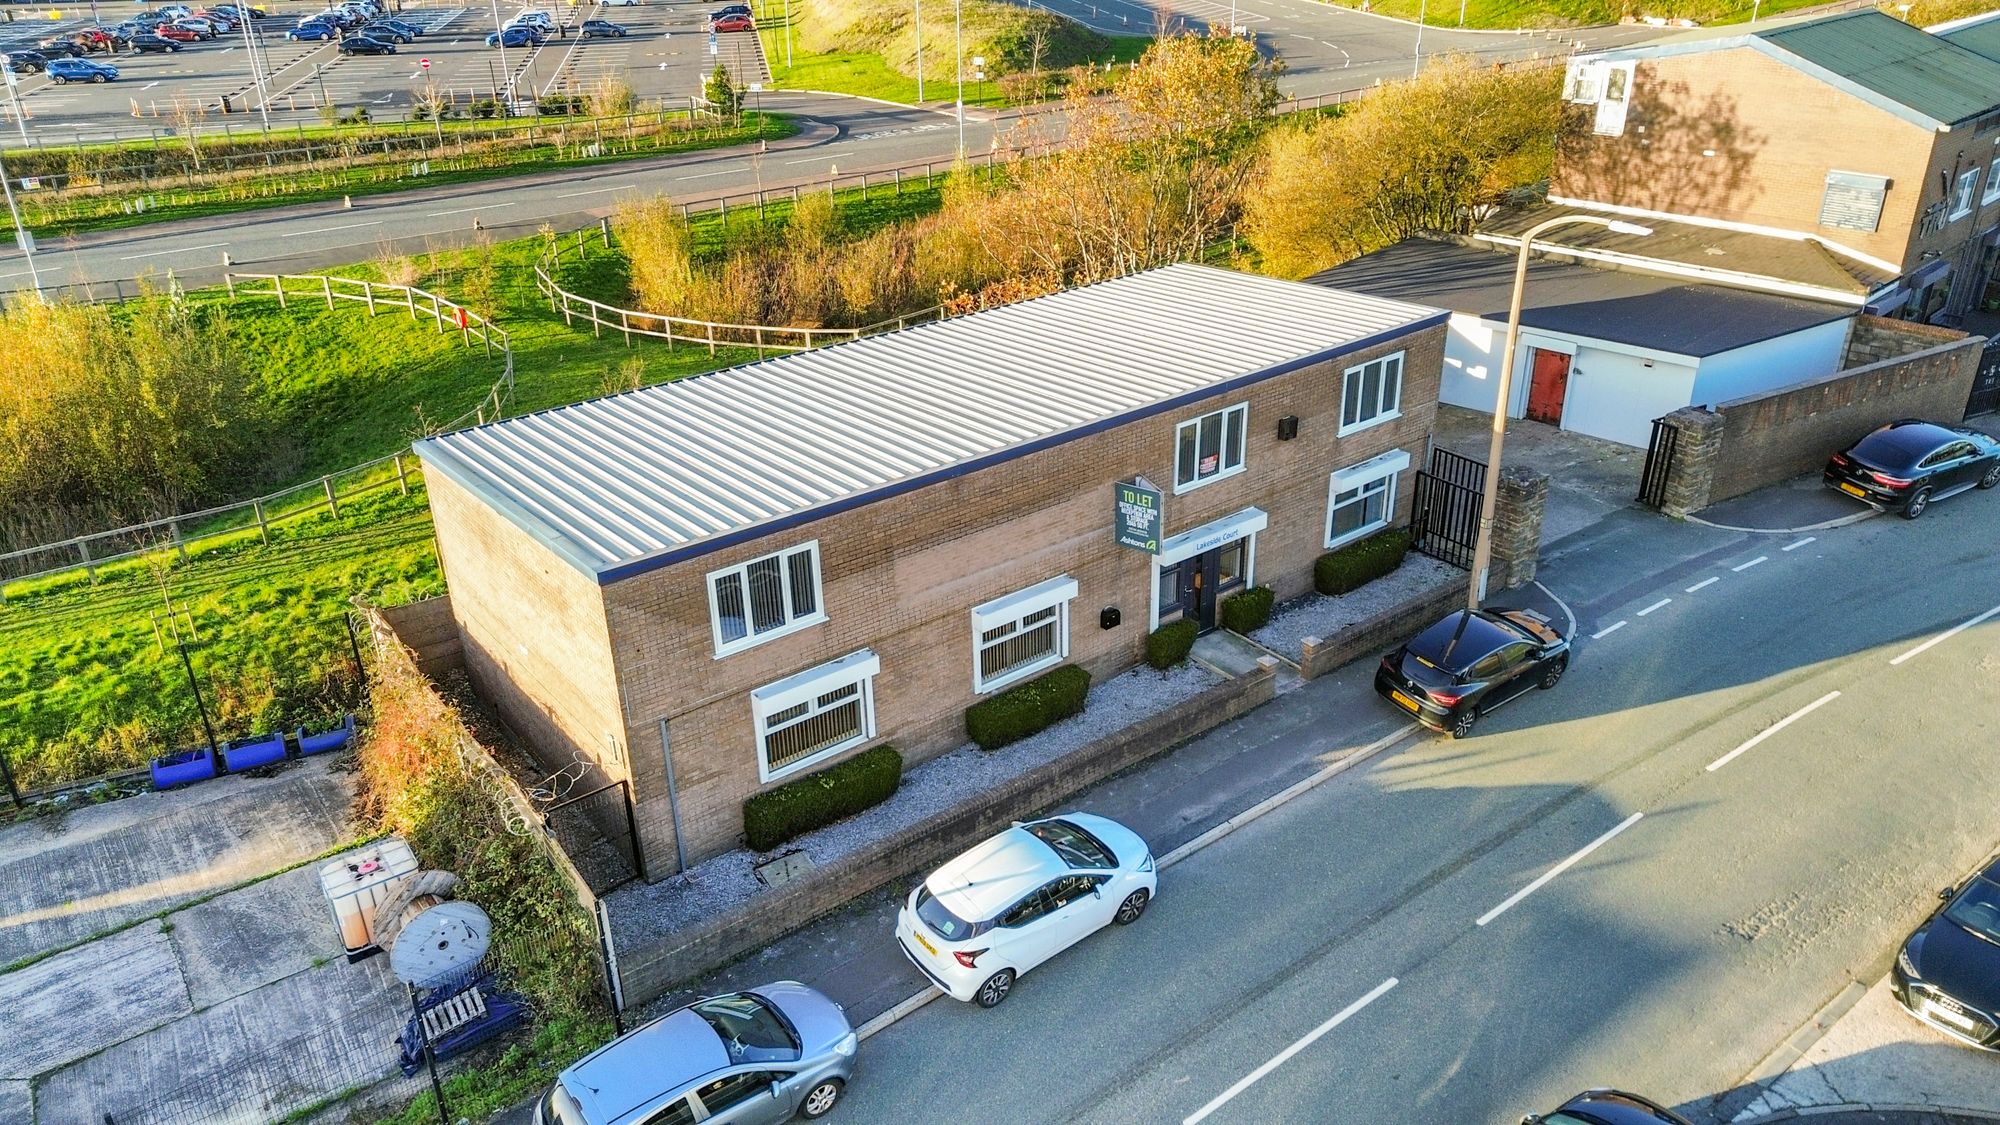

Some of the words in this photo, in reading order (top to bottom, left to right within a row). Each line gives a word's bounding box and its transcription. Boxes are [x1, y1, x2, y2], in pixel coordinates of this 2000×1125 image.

[1123, 490, 1134, 503] TO
[1137, 493, 1152, 508] LET
[1120, 536, 1145, 548] Ashtons
[1196, 537, 1221, 551] Lakeside
[1222, 529, 1239, 541] Court
